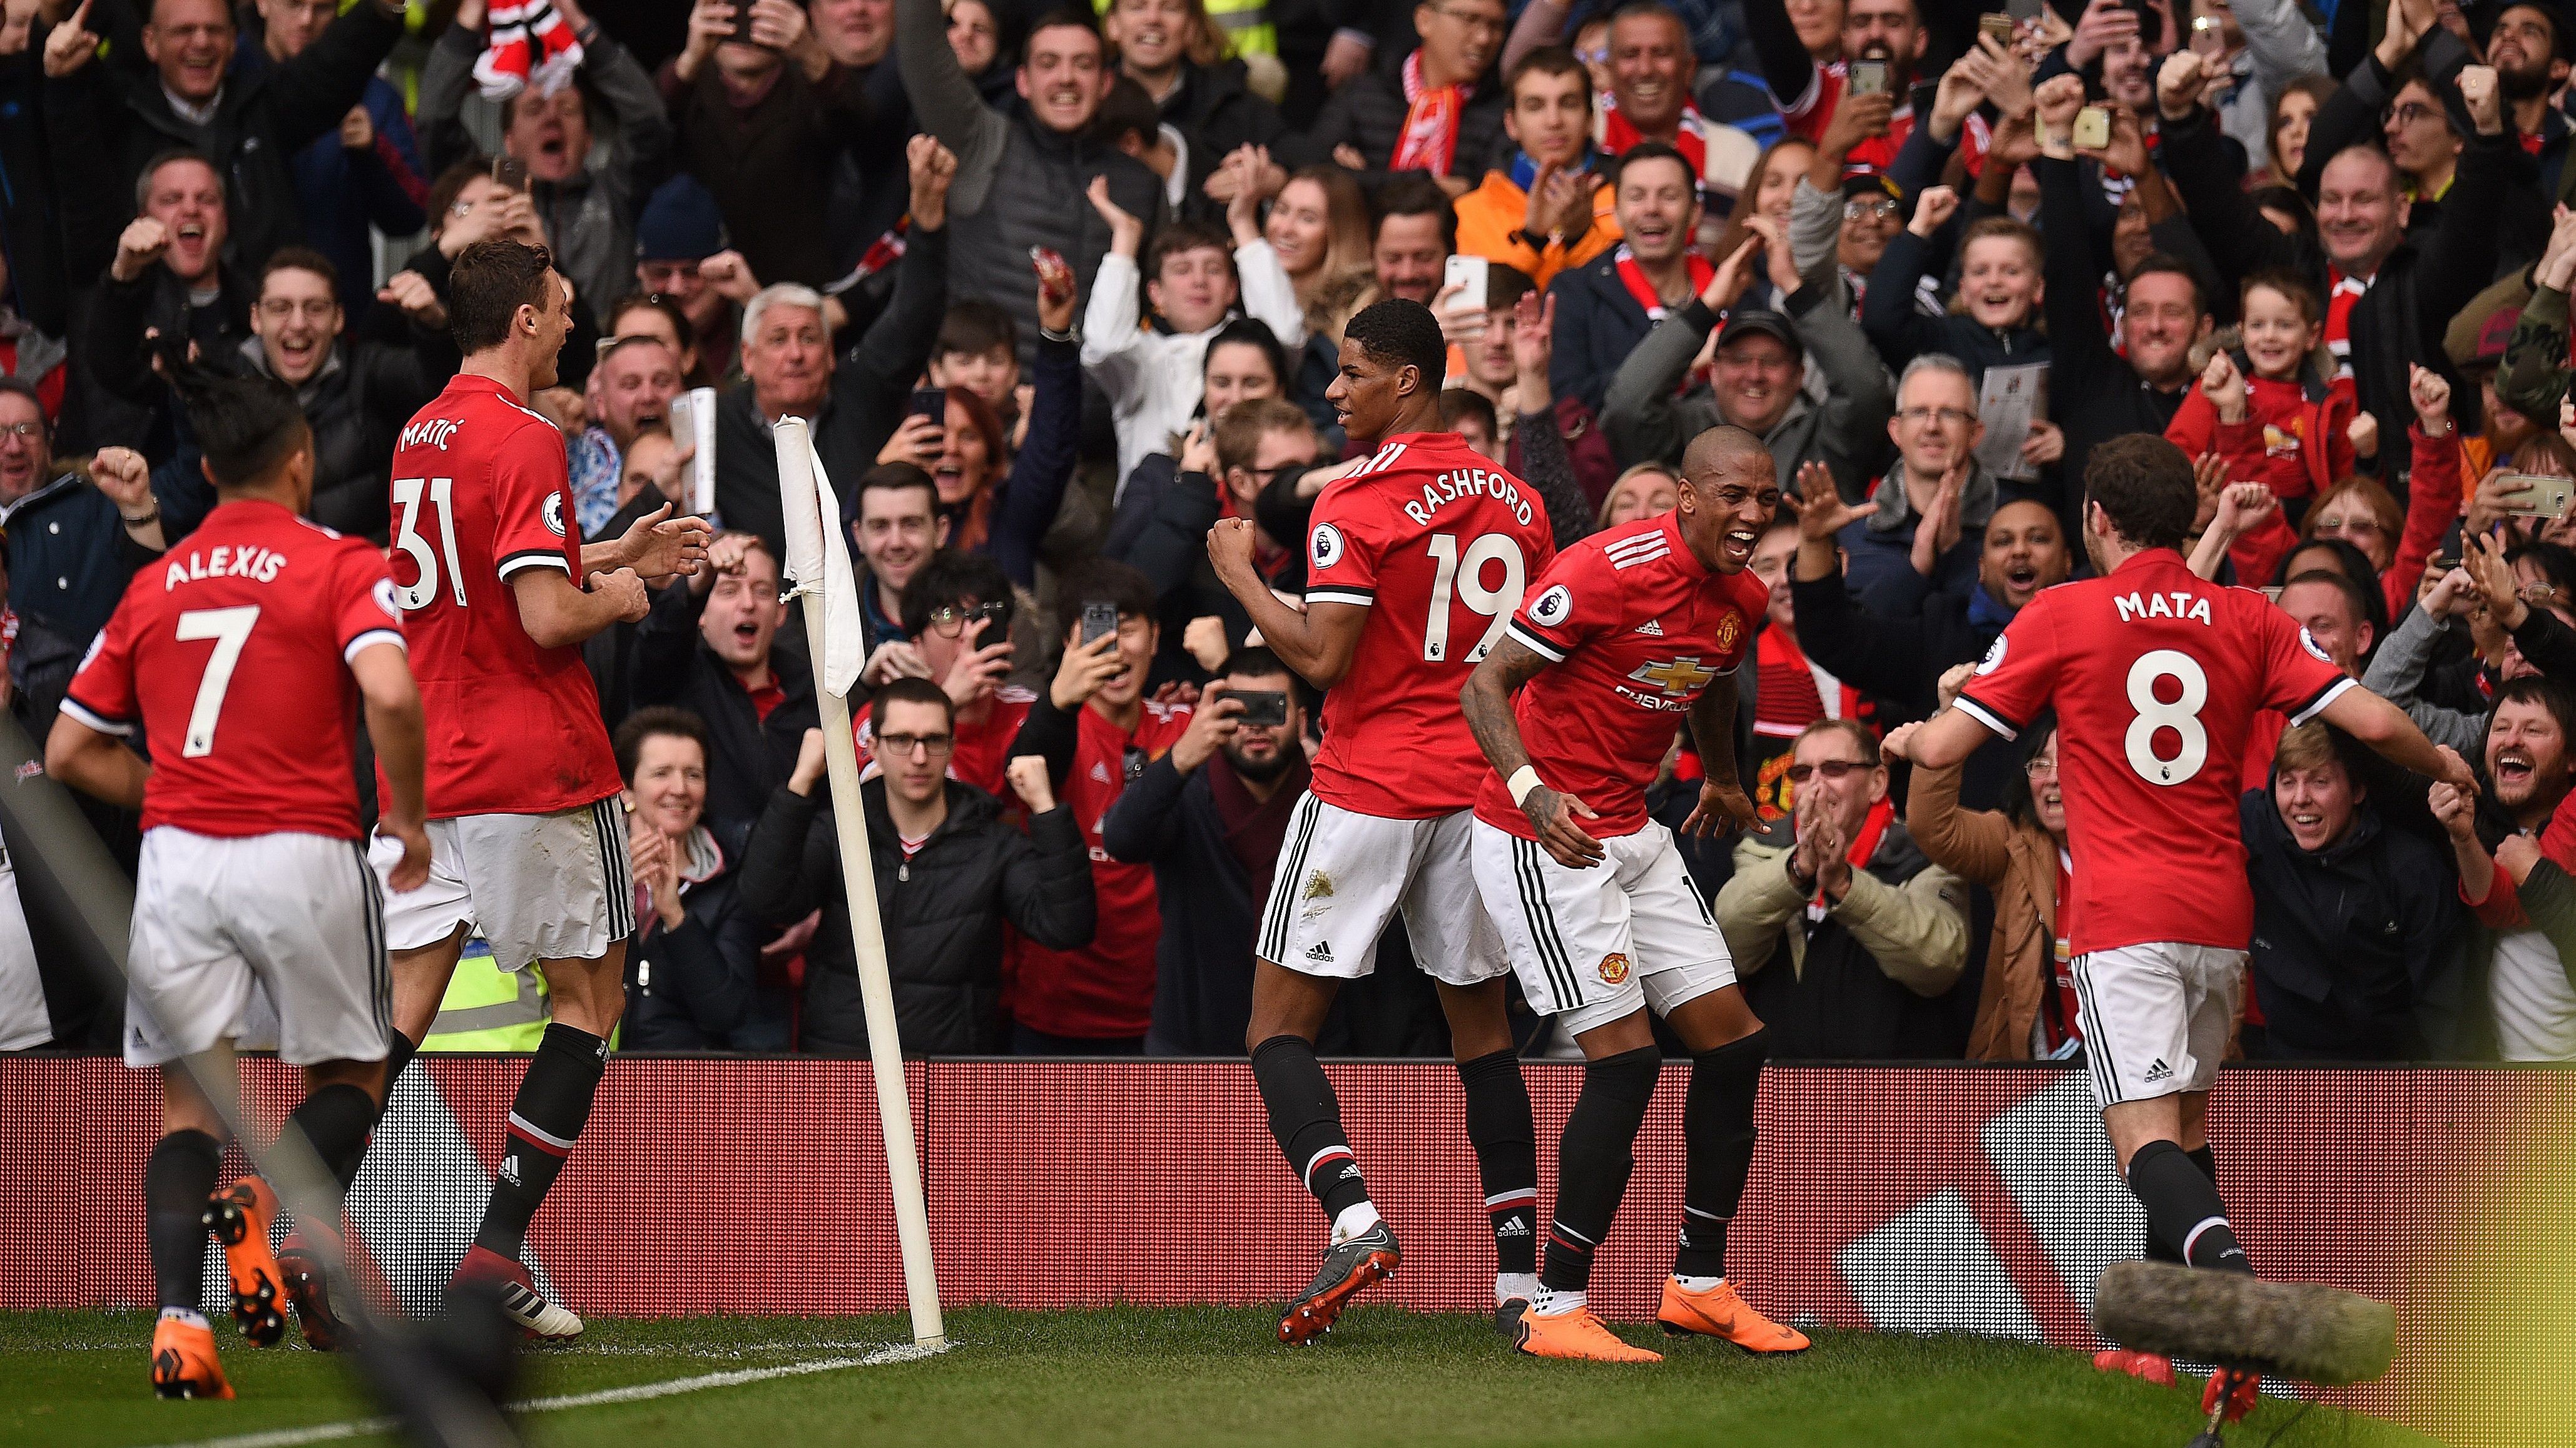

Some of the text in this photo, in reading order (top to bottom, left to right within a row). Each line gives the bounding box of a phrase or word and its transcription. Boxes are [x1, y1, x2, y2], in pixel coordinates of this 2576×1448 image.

[1404, 469, 1532, 526] RASHFORD
[165, 544, 288, 592] ALEXIS
[393, 477, 468, 610] 31
[1424, 533, 1525, 662] 19
[2113, 591, 2211, 626] MATA
[175, 604, 262, 759] 7
[2125, 649, 2208, 786] 8
[1305, 951, 1335, 963] adidas
[2144, 1070, 2174, 1083] adidas
[1497, 1228, 1530, 1237] adidas
